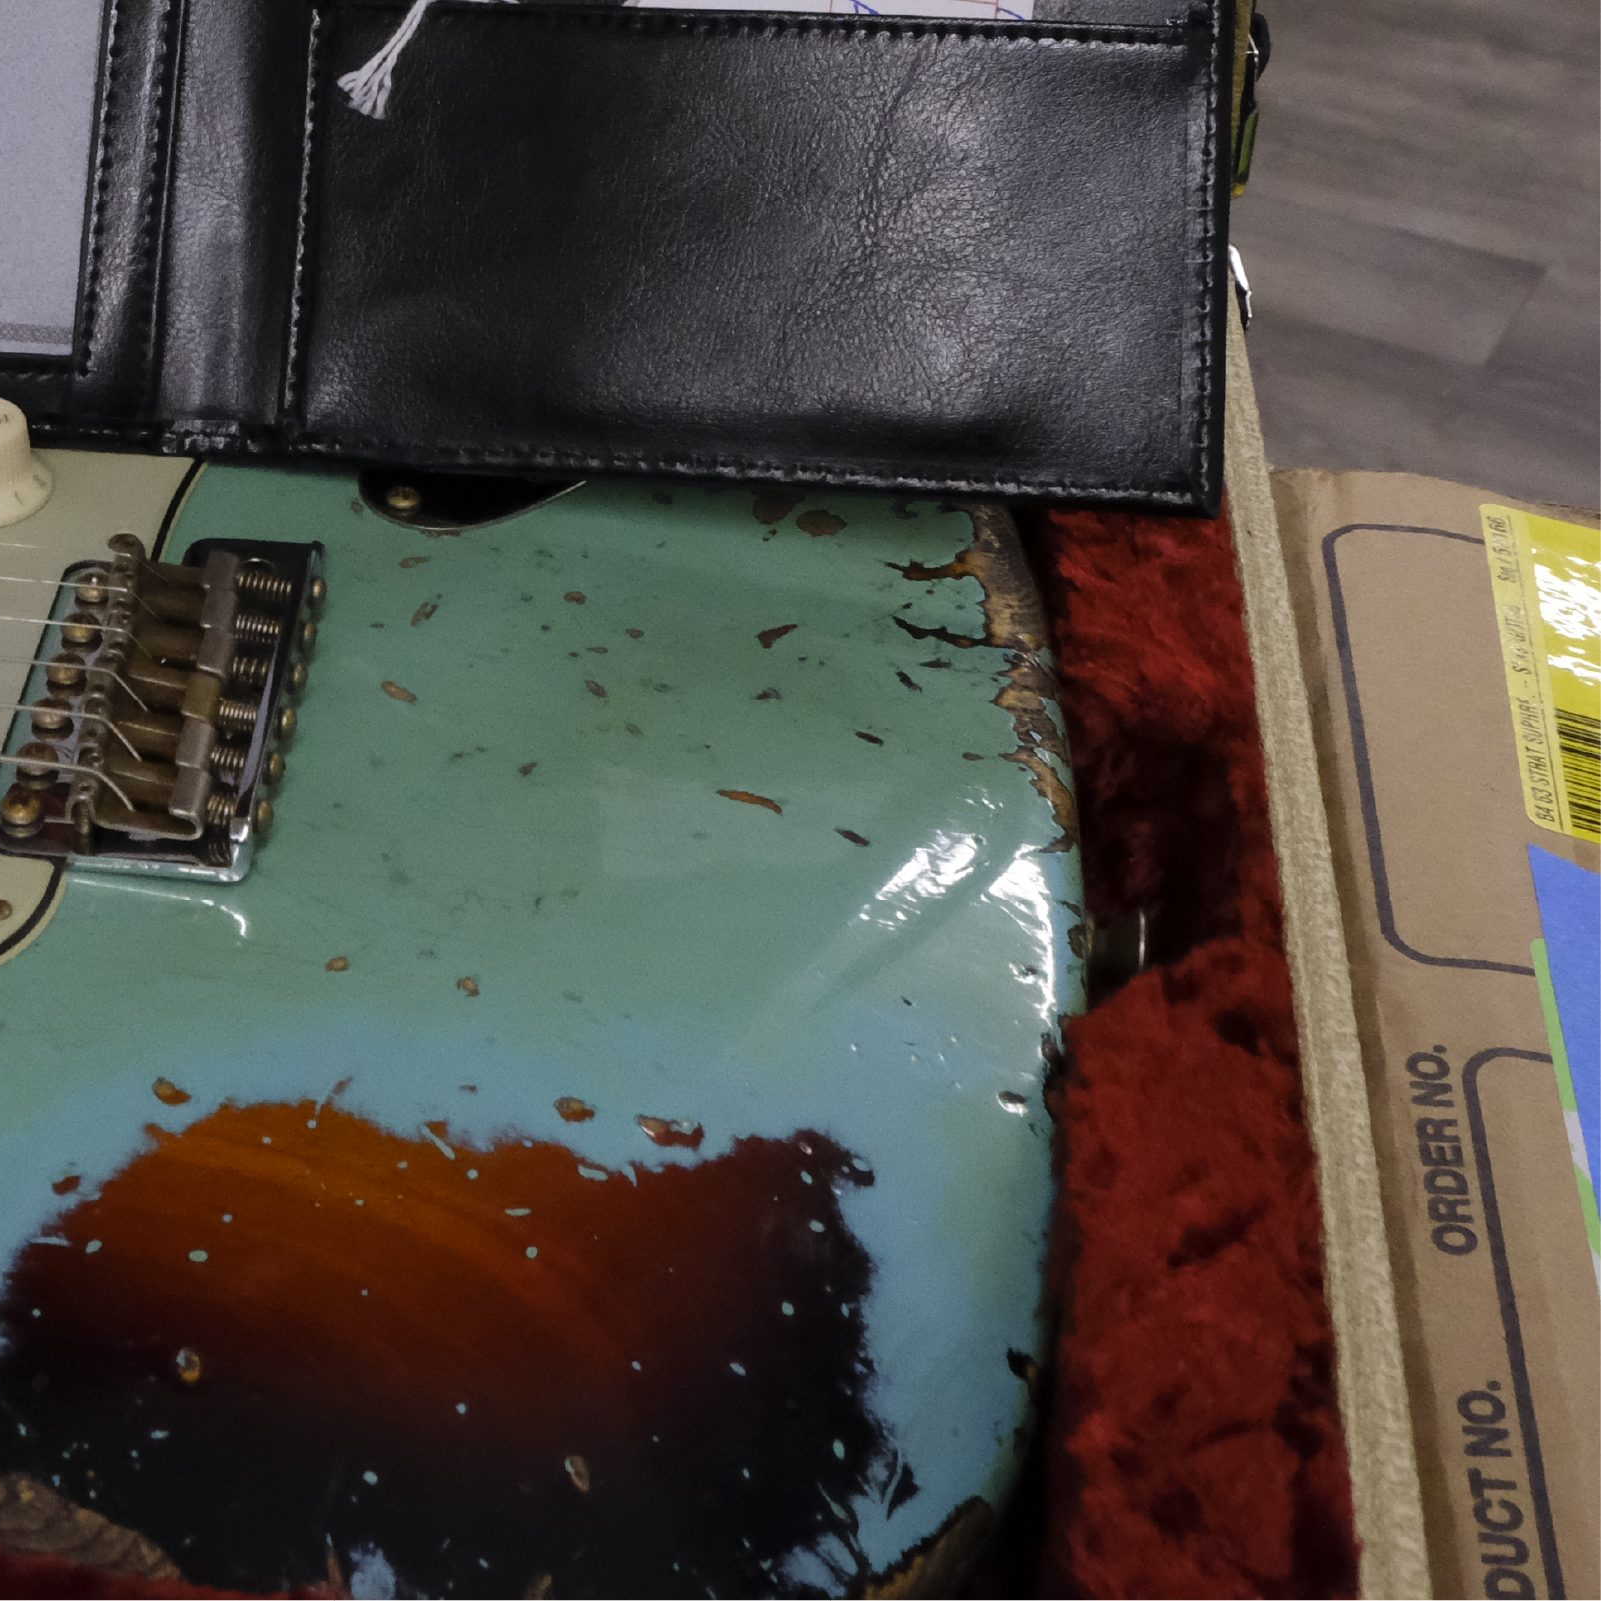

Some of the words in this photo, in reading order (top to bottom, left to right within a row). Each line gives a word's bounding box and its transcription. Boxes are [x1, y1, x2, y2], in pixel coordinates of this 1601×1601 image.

[1526, 746, 1550, 787] STRAT
[1405, 1043, 1456, 1108] NO.
[1416, 1116, 1478, 1256] ORDER
[1457, 1380, 1512, 1459] NO.
